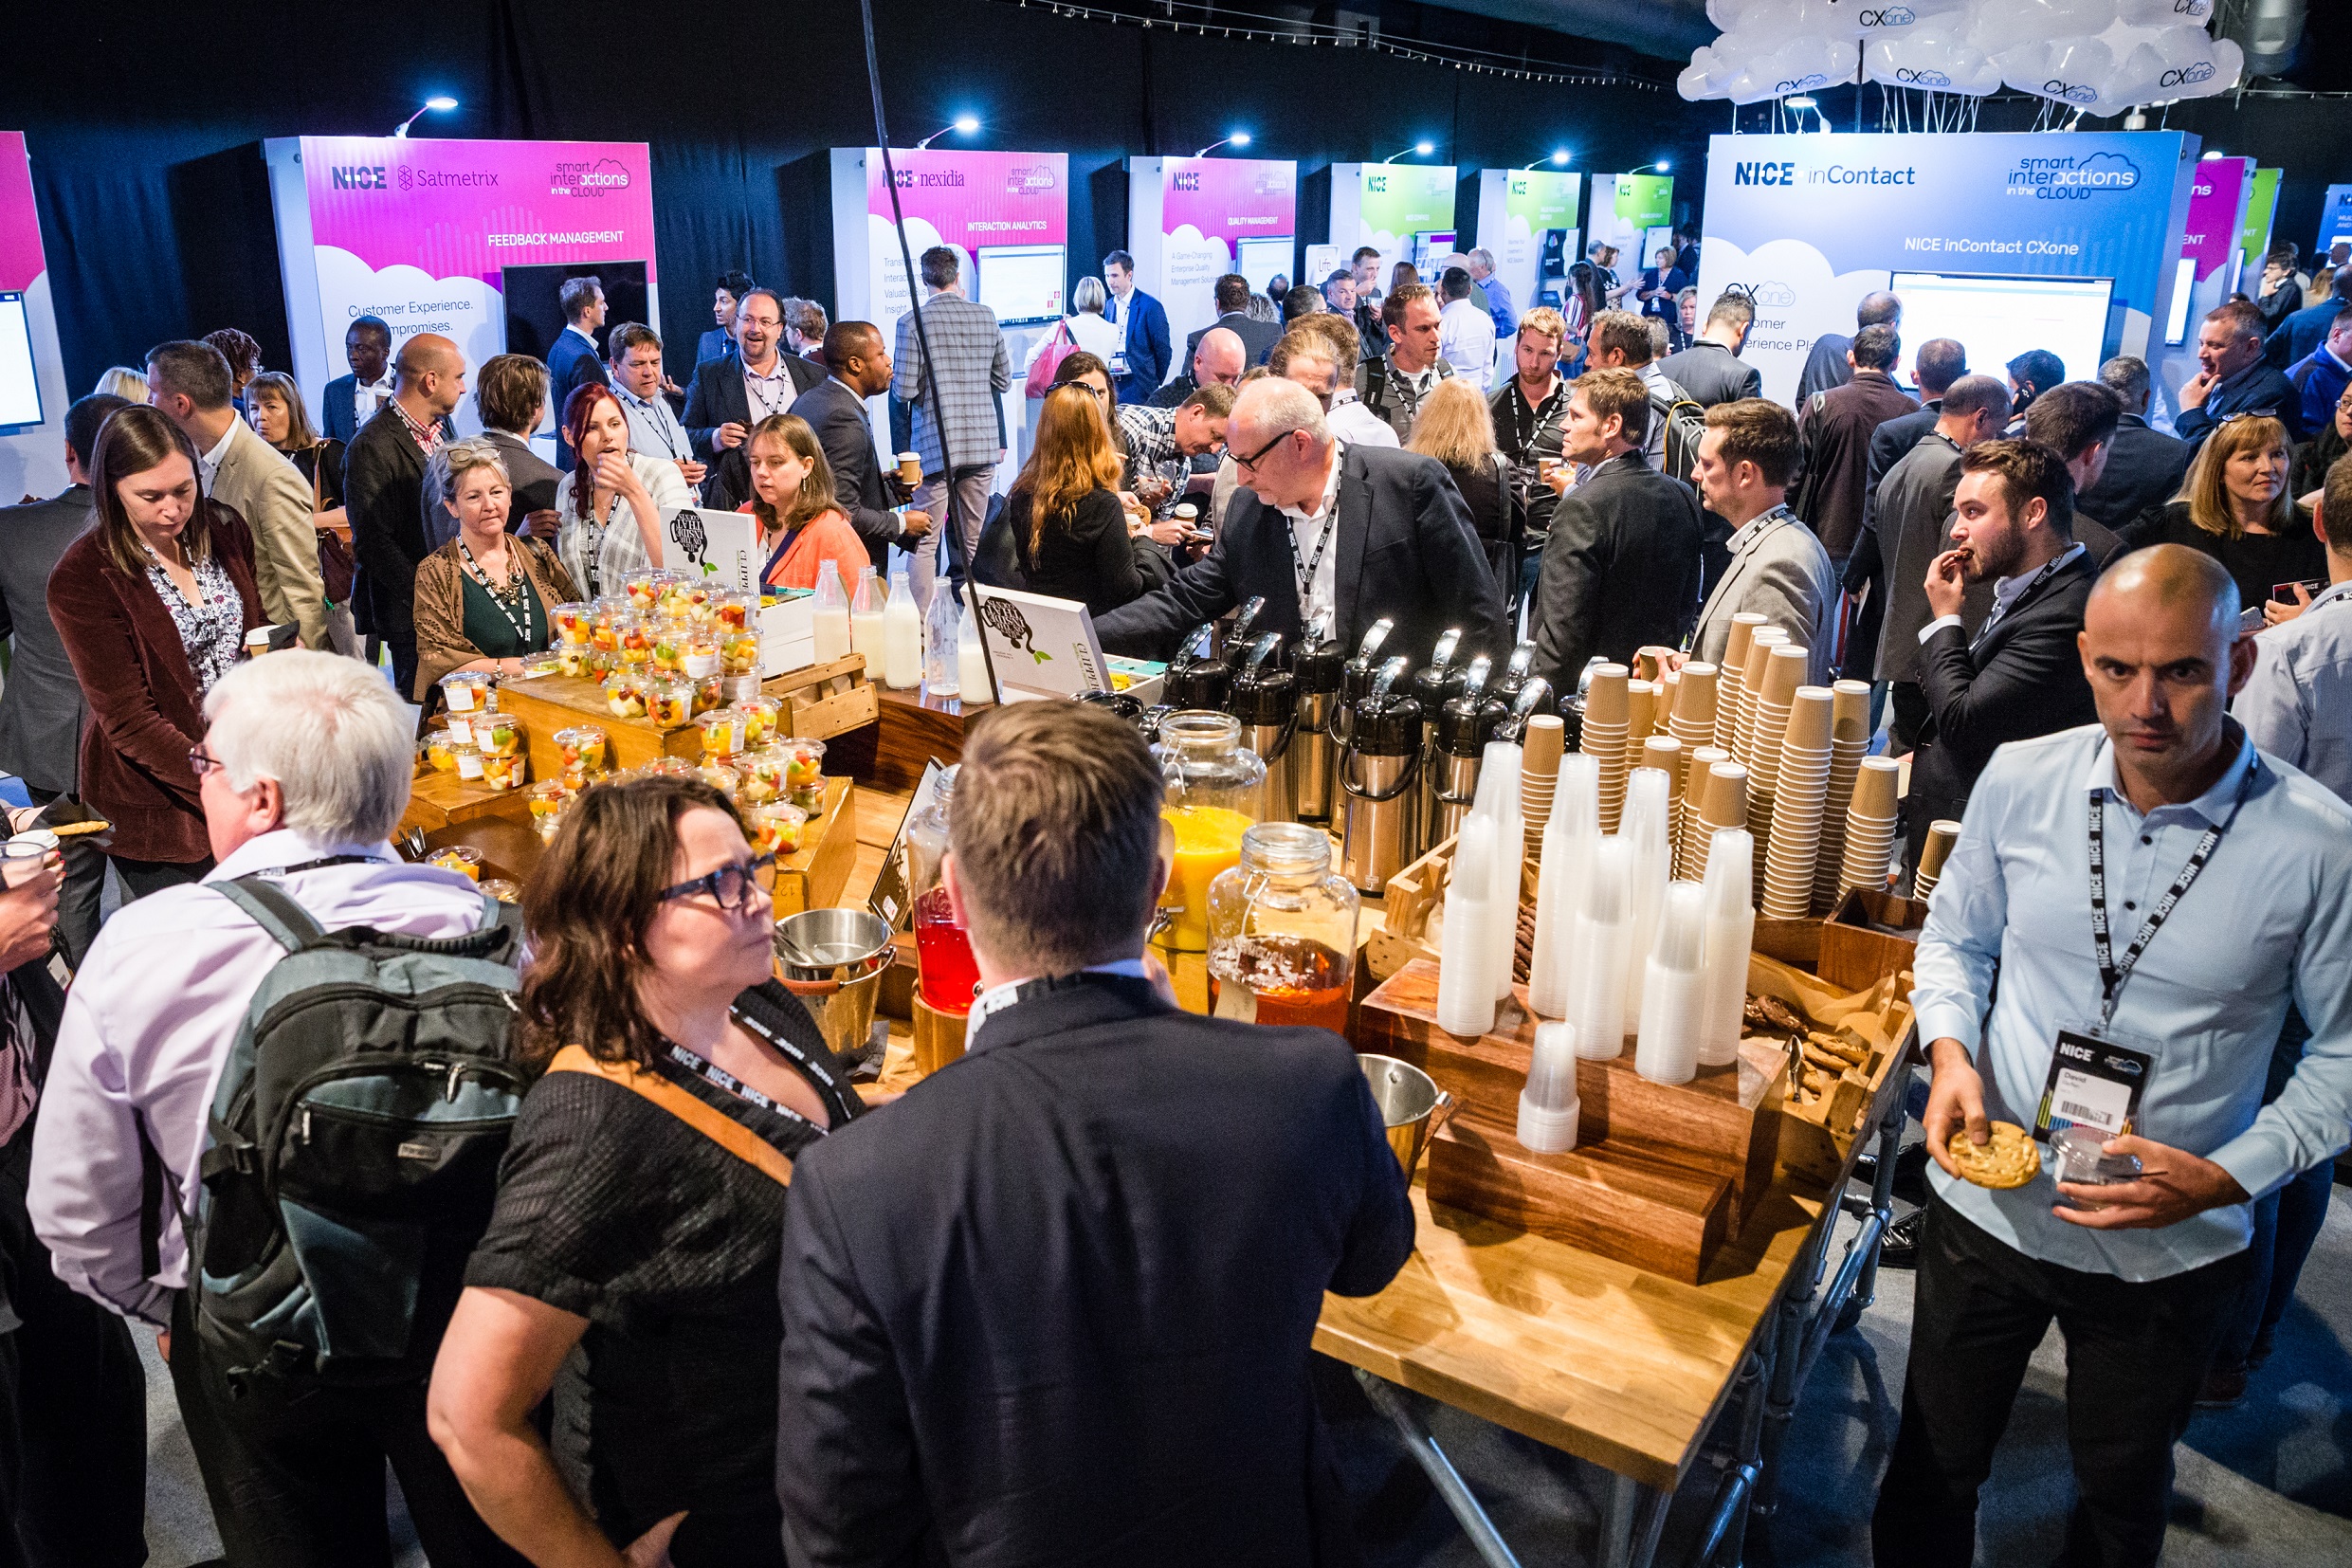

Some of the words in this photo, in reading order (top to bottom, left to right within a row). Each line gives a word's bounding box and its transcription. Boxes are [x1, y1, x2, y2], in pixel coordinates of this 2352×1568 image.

[1860, 9, 1911, 27] CXone
[1896, 68, 1949, 86] CXone
[2161, 64, 2214, 88] CXone
[2044, 80, 2096, 103] CXone
[556, 162, 591, 173] smart
[2020, 156, 2074, 172] smart
[332, 166, 387, 190] NICE
[417, 170, 499, 188] Satmetrix
[551, 171, 629, 187] interactions
[921, 170, 965, 187] nexidia
[1173, 173, 1199, 191] NICE
[1735, 161, 1795, 186] NICE
[1808, 165, 1915, 186] inContact
[2008, 169, 2136, 188] interactions
[571, 187, 604, 198] CLOUD
[1368, 176, 1387, 192] NICE
[2007, 187, 2015, 196] in
[2017, 187, 2035, 197] the
[2036, 188, 2091, 200] CLOUD
[967, 221, 1011, 232] INTERACTION
[1012, 220, 1048, 230] ANALYTICS
[487, 233, 548, 246] FEEDBACK
[550, 230, 624, 245] MANAGEMENT
[1905, 237, 1942, 251] NICE
[1944, 238, 2023, 254] inContact
[2026, 242, 2079, 255] CXone
[348, 303, 406, 318] Customer
[409, 300, 473, 315] Experience.
[884, 304, 907, 315] Insight
[675, 519, 702, 531] THAT
[1758, 516, 1773, 529] NICE
[676, 528, 703, 539] INSIDE
[1318, 532, 1328, 548] NICE
[1293, 549, 1303, 565] NICE
[1310, 550, 1321, 566] NICE
[2050, 554, 2063, 568] NIC
[2033, 571, 2050, 586] NICE
[2089, 806, 2102, 831] NICE
[2088, 839, 2103, 866] NICE
[2195, 830, 2218, 860] NICE
[2176, 862, 2199, 891] NICE
[2090, 872, 2104, 900] NICE
[2153, 892, 2178, 921] NICE
[2093, 907, 2106, 934] NICE
[2133, 921, 2157, 951] NICE
[2097, 941, 2111, 969] NICE
[2059, 1043, 2093, 1062] NICE
[670, 1045, 702, 1070] NICE
[705, 1065, 737, 1090] NICE
[739, 1085, 771, 1108] NICE
